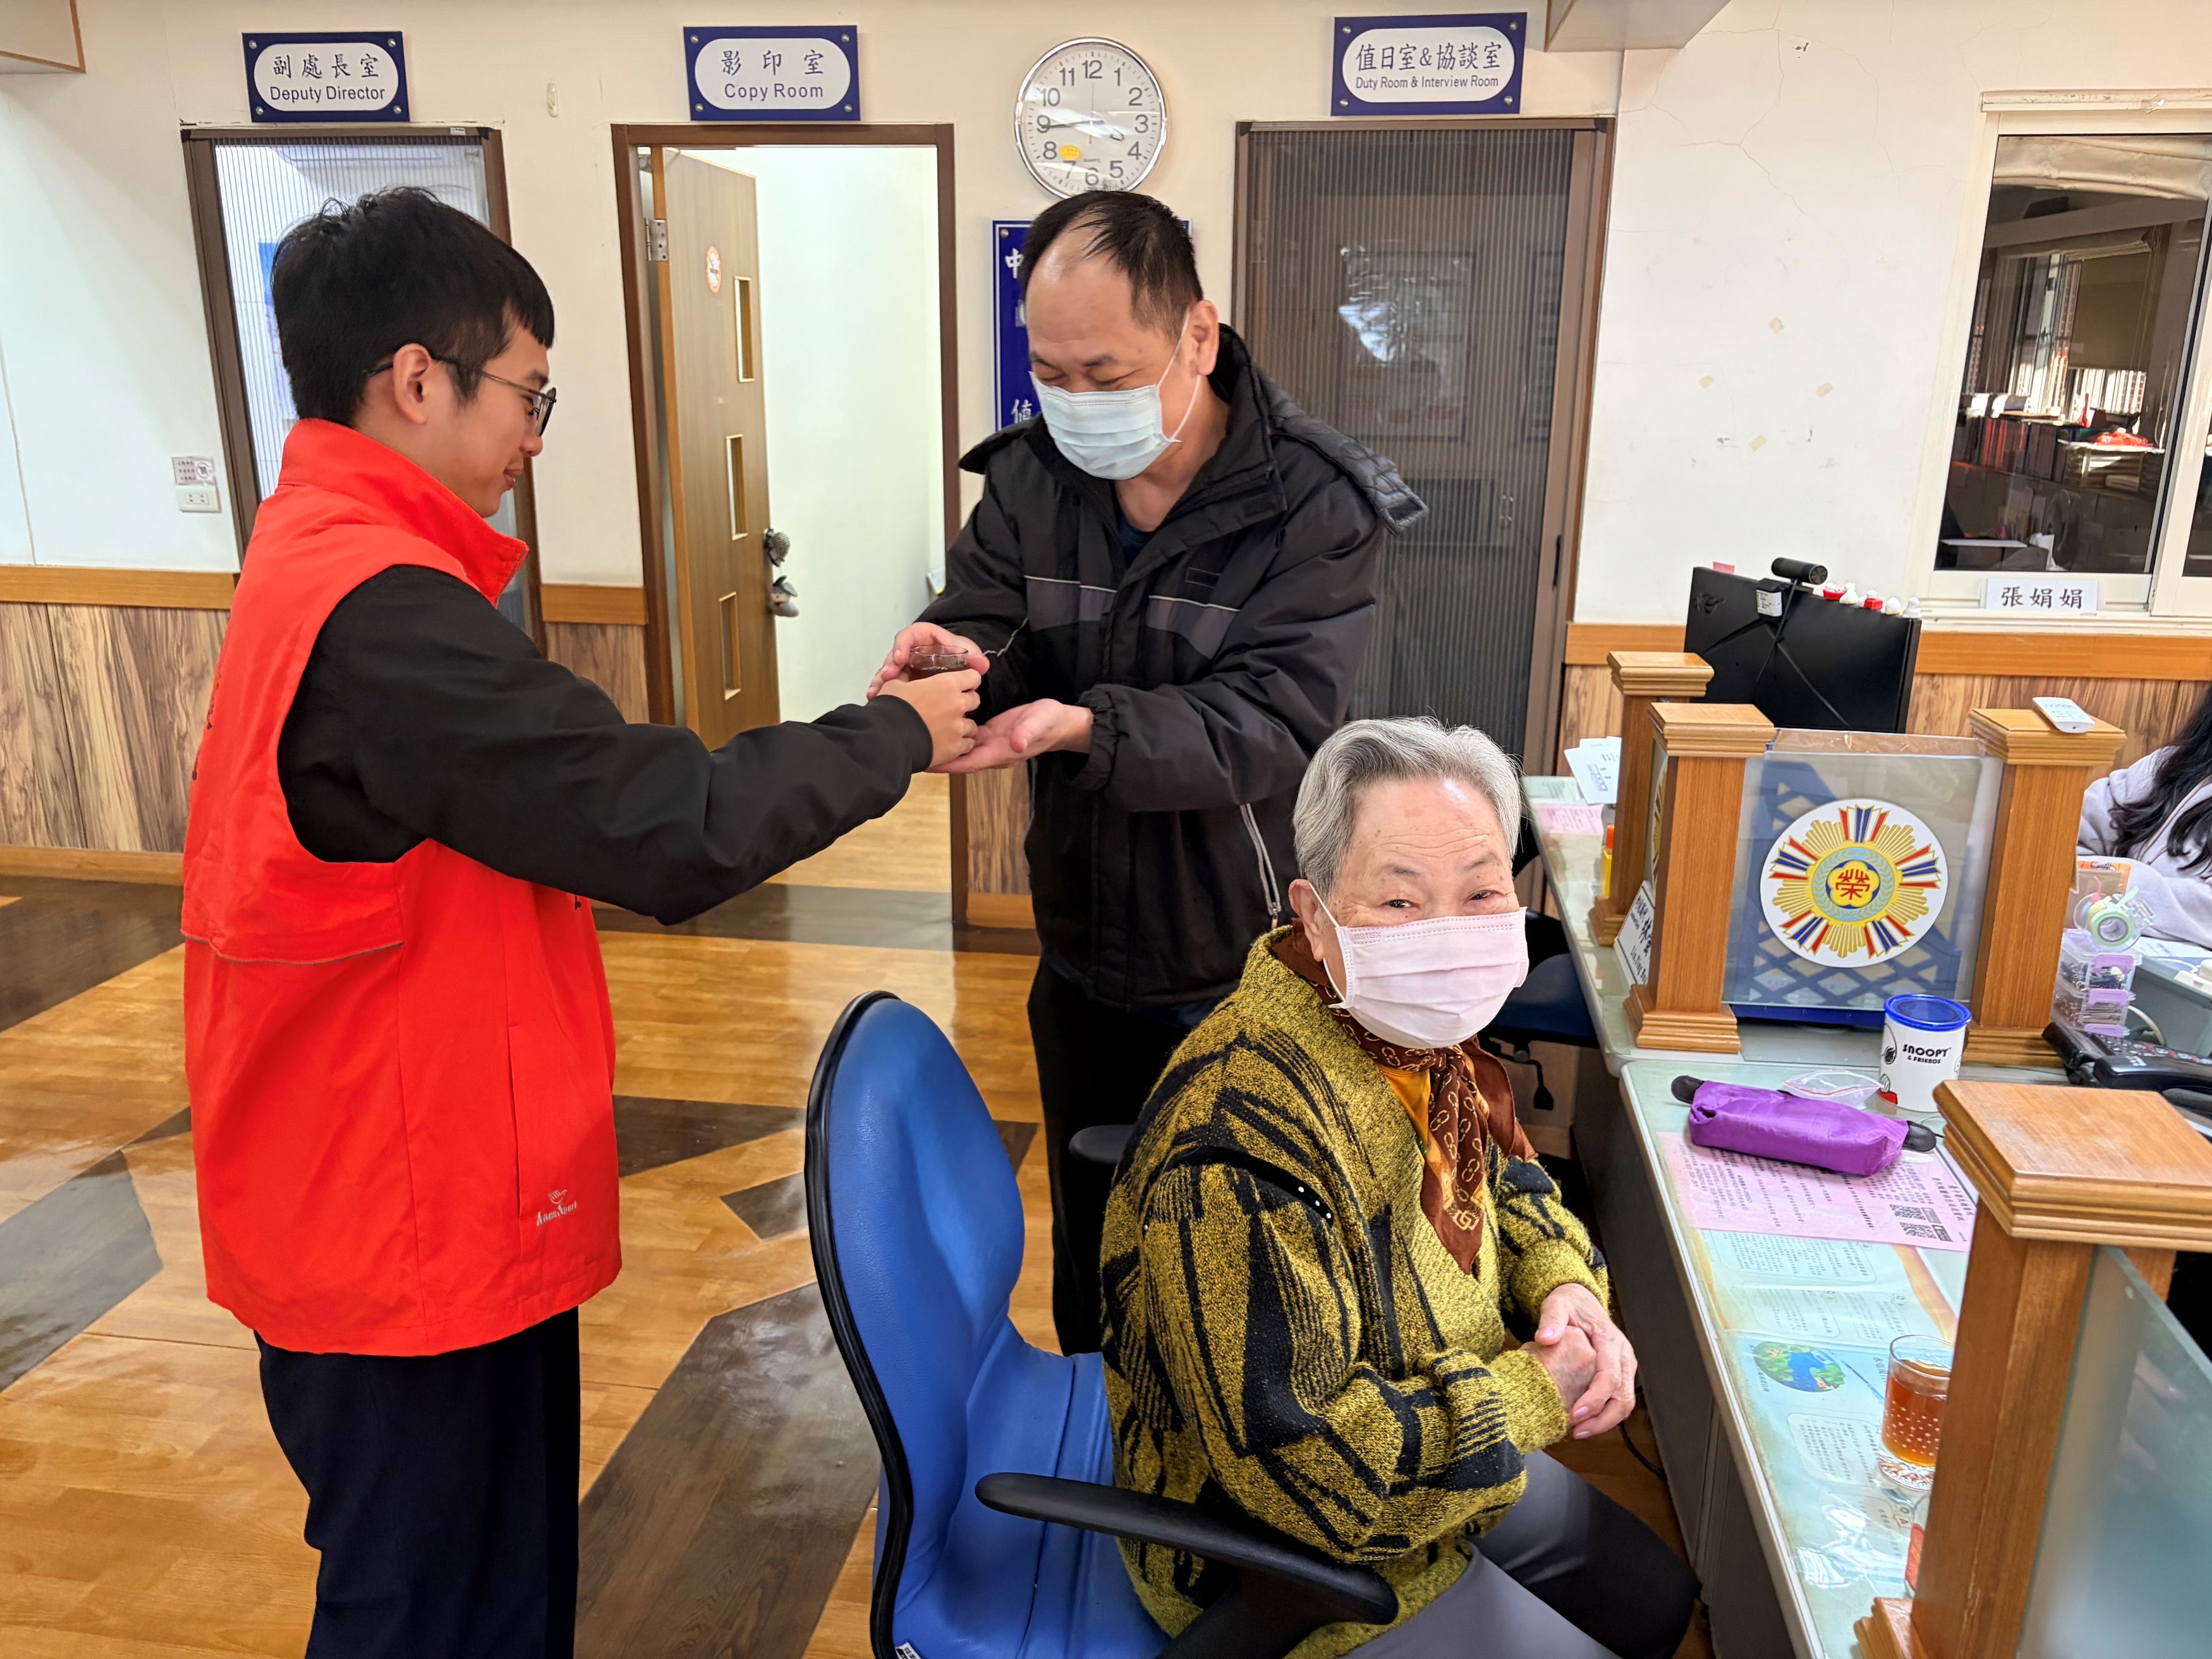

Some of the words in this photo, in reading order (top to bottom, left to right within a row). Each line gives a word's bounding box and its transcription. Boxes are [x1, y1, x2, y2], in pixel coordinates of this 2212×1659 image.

[272, 53, 379, 79] 副處長室
[721, 49, 824, 76] 影印室
[1356, 41, 1502, 72] 值日室&協談室
[1059, 68, 1075, 86] 11
[1082, 60, 1102, 79] 12
[1114, 68, 1121, 87] 1
[724, 83, 769, 101] Copy
[774, 83, 823, 98] Room
[1356, 76, 1378, 90] Duty
[1380, 76, 1408, 88] Room
[1411, 76, 1418, 87] &
[1421, 75, 1468, 87] Interview
[1471, 75, 1498, 87] Room
[270, 86, 321, 103] Deputy
[326, 85, 386, 100] Director
[1041, 88, 1060, 107] 10
[1128, 87, 1143, 106] 2
[1037, 114, 1051, 133] 9
[1135, 114, 1148, 133] 3
[1043, 141, 1057, 160] 8
[1127, 141, 1142, 160] 4
[1063, 161, 1077, 179] 7
[1085, 167, 1098, 185] 6
[1110, 161, 1124, 178] 5
[2001, 585, 2083, 610] 張娟娟
[1835, 868, 1871, 901] 榮
[1902, 1043, 1952, 1057] SNOOPY
[1913, 1056, 1942, 1064] FRIENDS
